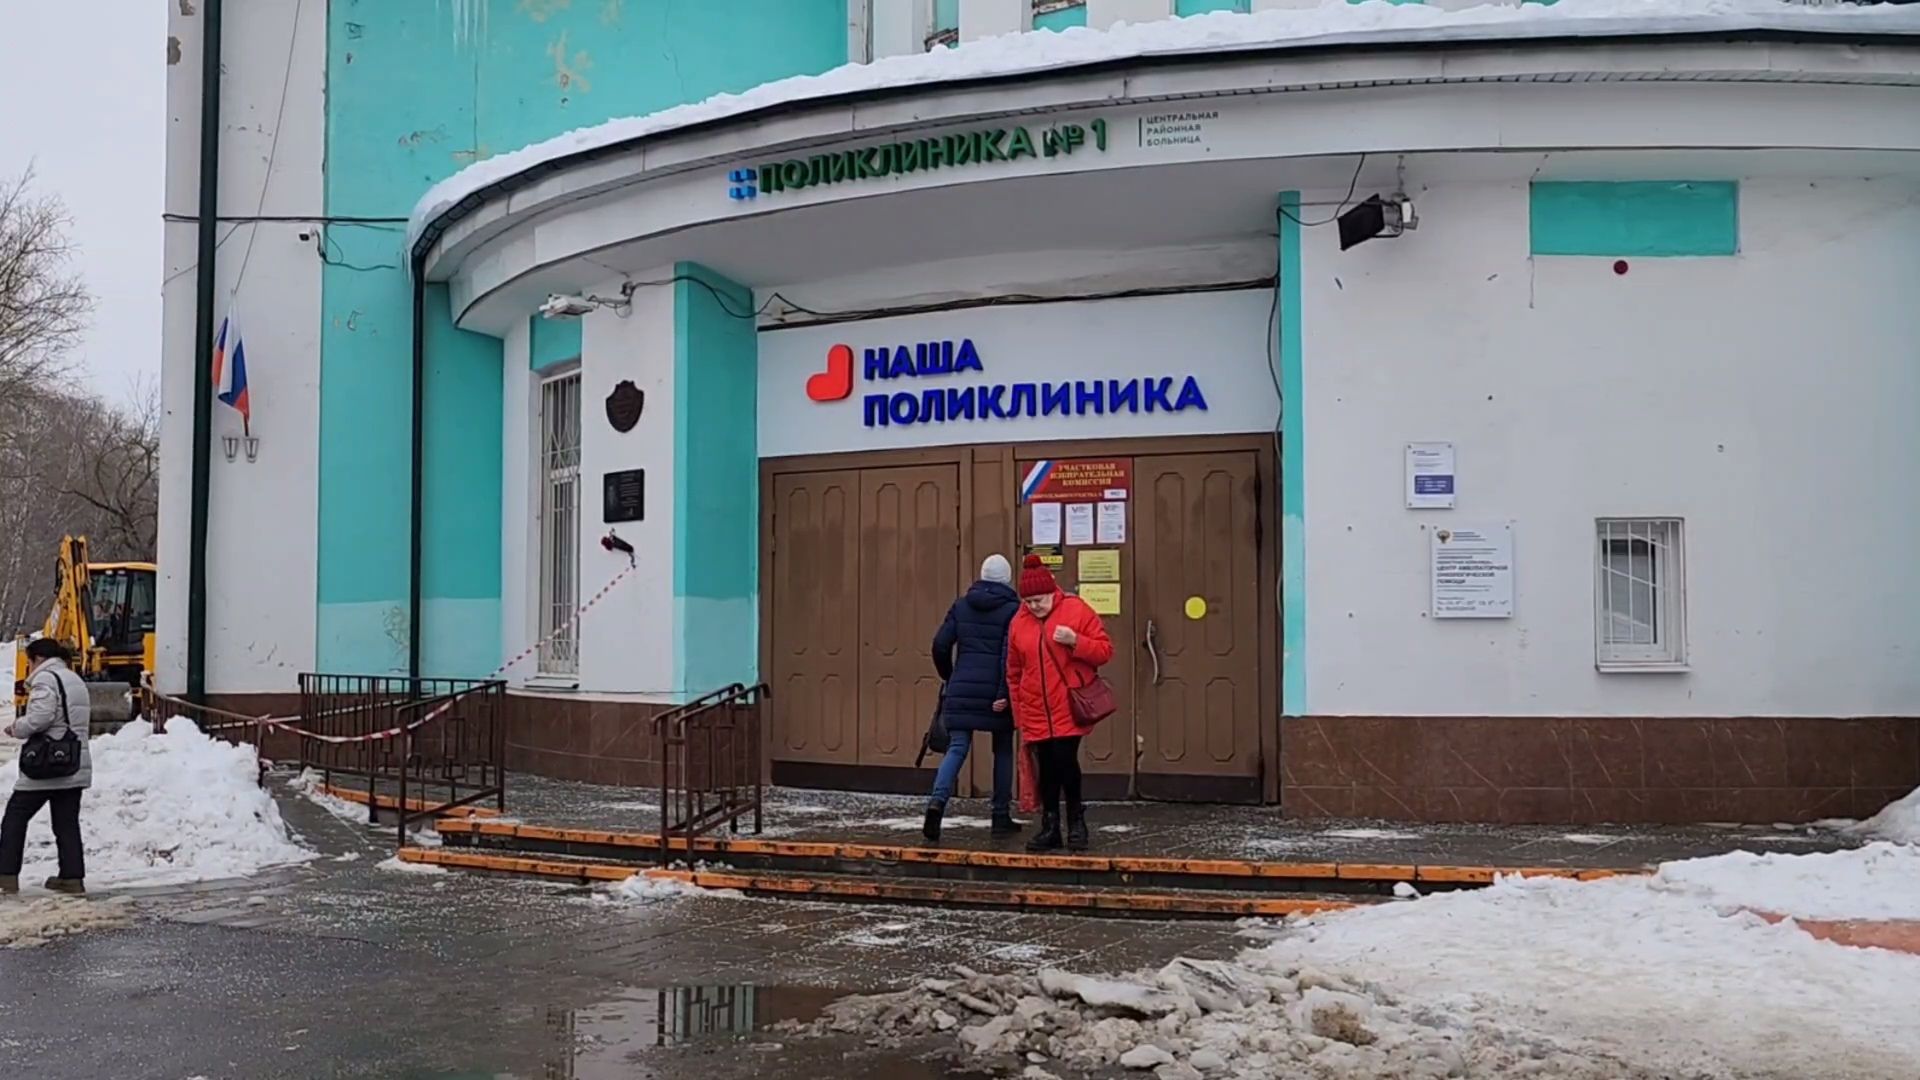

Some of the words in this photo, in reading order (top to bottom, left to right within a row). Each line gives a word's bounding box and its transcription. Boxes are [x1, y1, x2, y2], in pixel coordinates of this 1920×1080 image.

[1146, 111, 1219, 124] ЦЕНТРАЛЬНАЯ
[1146, 124, 1201, 135] РАЙОННАЯ
[1146, 135, 1201, 147] БОЛЬНИЦА
[758, 126, 1037, 194] ПОЛИКЛИНИКА
[1043, 123, 1085, 158] №
[1091, 118, 1107, 152] 1
[864, 338, 983, 381] НАША
[864, 375, 1208, 427] ПОЛИКЛИНИКА
[1058, 462, 1116, 472] УЧАСТКОВАЯ
[1050, 470, 1125, 480] ИЗБИРАТЕЛЬНАЯ
[1062, 478, 1112, 487] КОМИССИЯ
